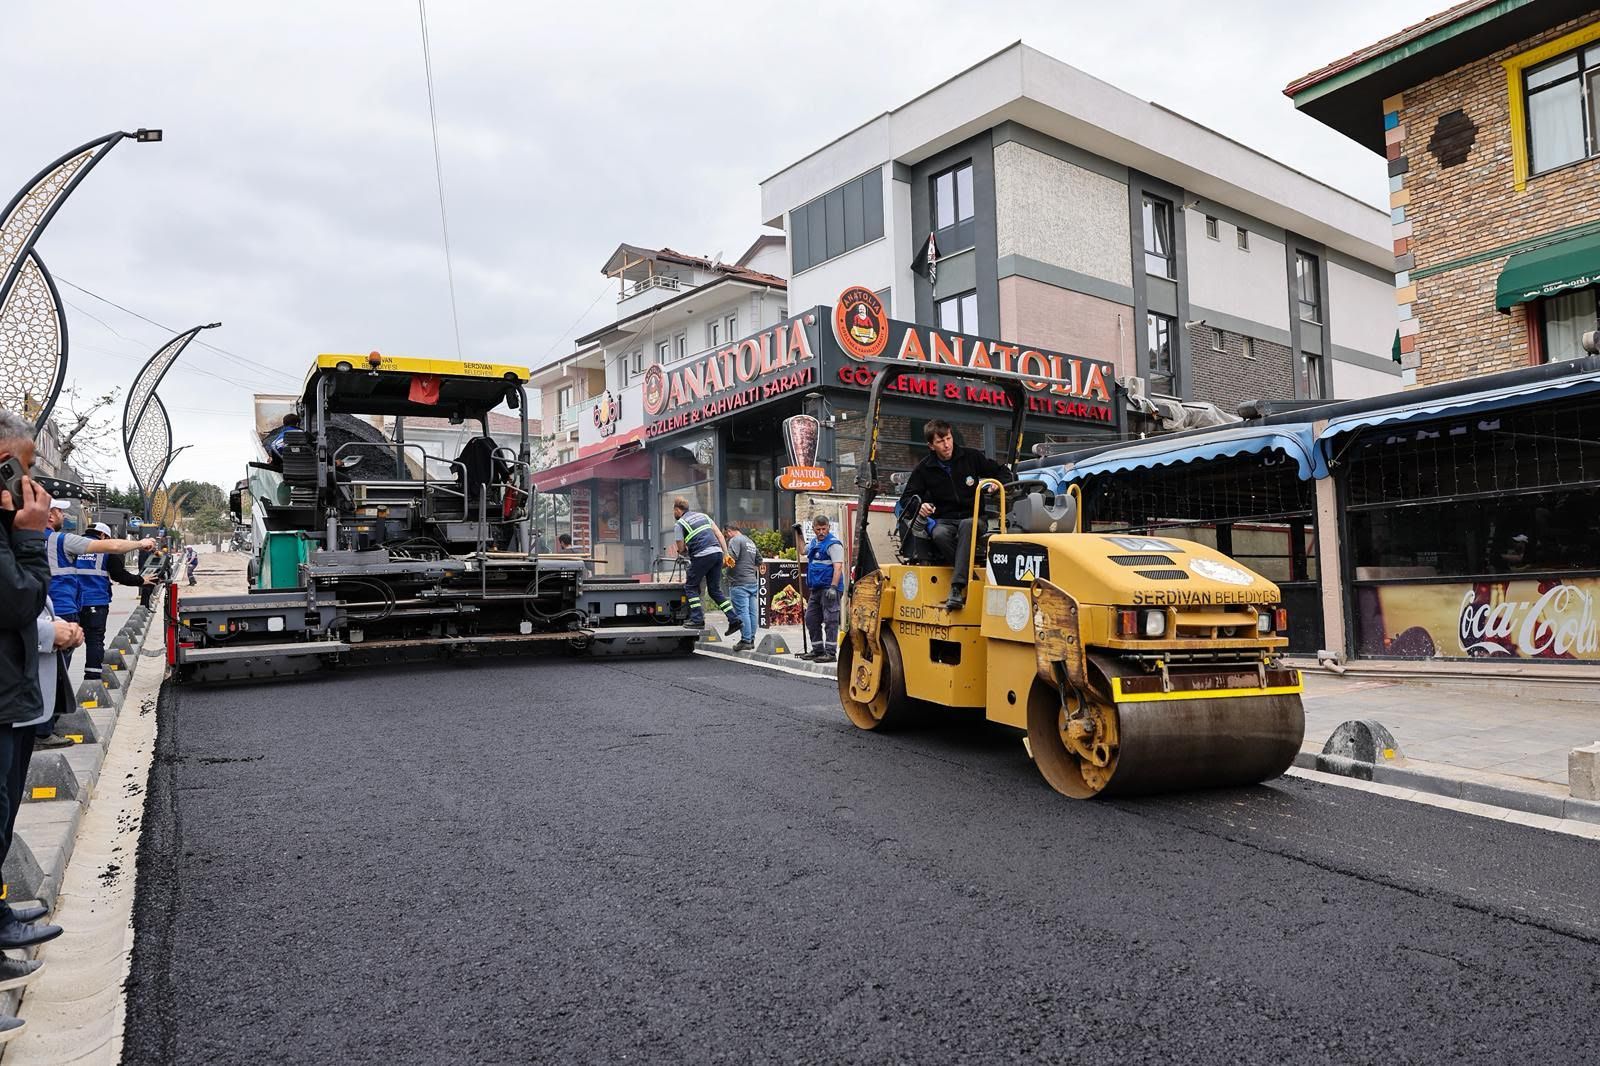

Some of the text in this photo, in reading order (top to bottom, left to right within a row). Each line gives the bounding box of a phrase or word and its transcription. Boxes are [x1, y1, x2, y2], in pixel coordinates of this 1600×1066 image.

[843, 291, 880, 313] ANATOLIA
[667, 318, 814, 412] ANATOLIA
[897, 327, 1111, 402] ANATOLIA
[645, 413, 689, 438] GÖZLEME
[692, 409, 700, 422] &
[702, 387, 760, 418] KAHVALTI
[763, 367, 813, 398] SARAYI
[944, 382, 962, 399] &
[966, 386, 1052, 412] KAHLTI
[1055, 400, 1113, 421] SARAYI
[788, 479, 826, 489] döner
[790, 468, 825, 479] ANATOLIA
[993, 553, 1043, 580] CB34 CAT
[759, 577, 768, 626] DÖNER
[1132, 587, 1211, 605] SERDİVAN
[1457, 584, 1598, 656] Coca-Cola
